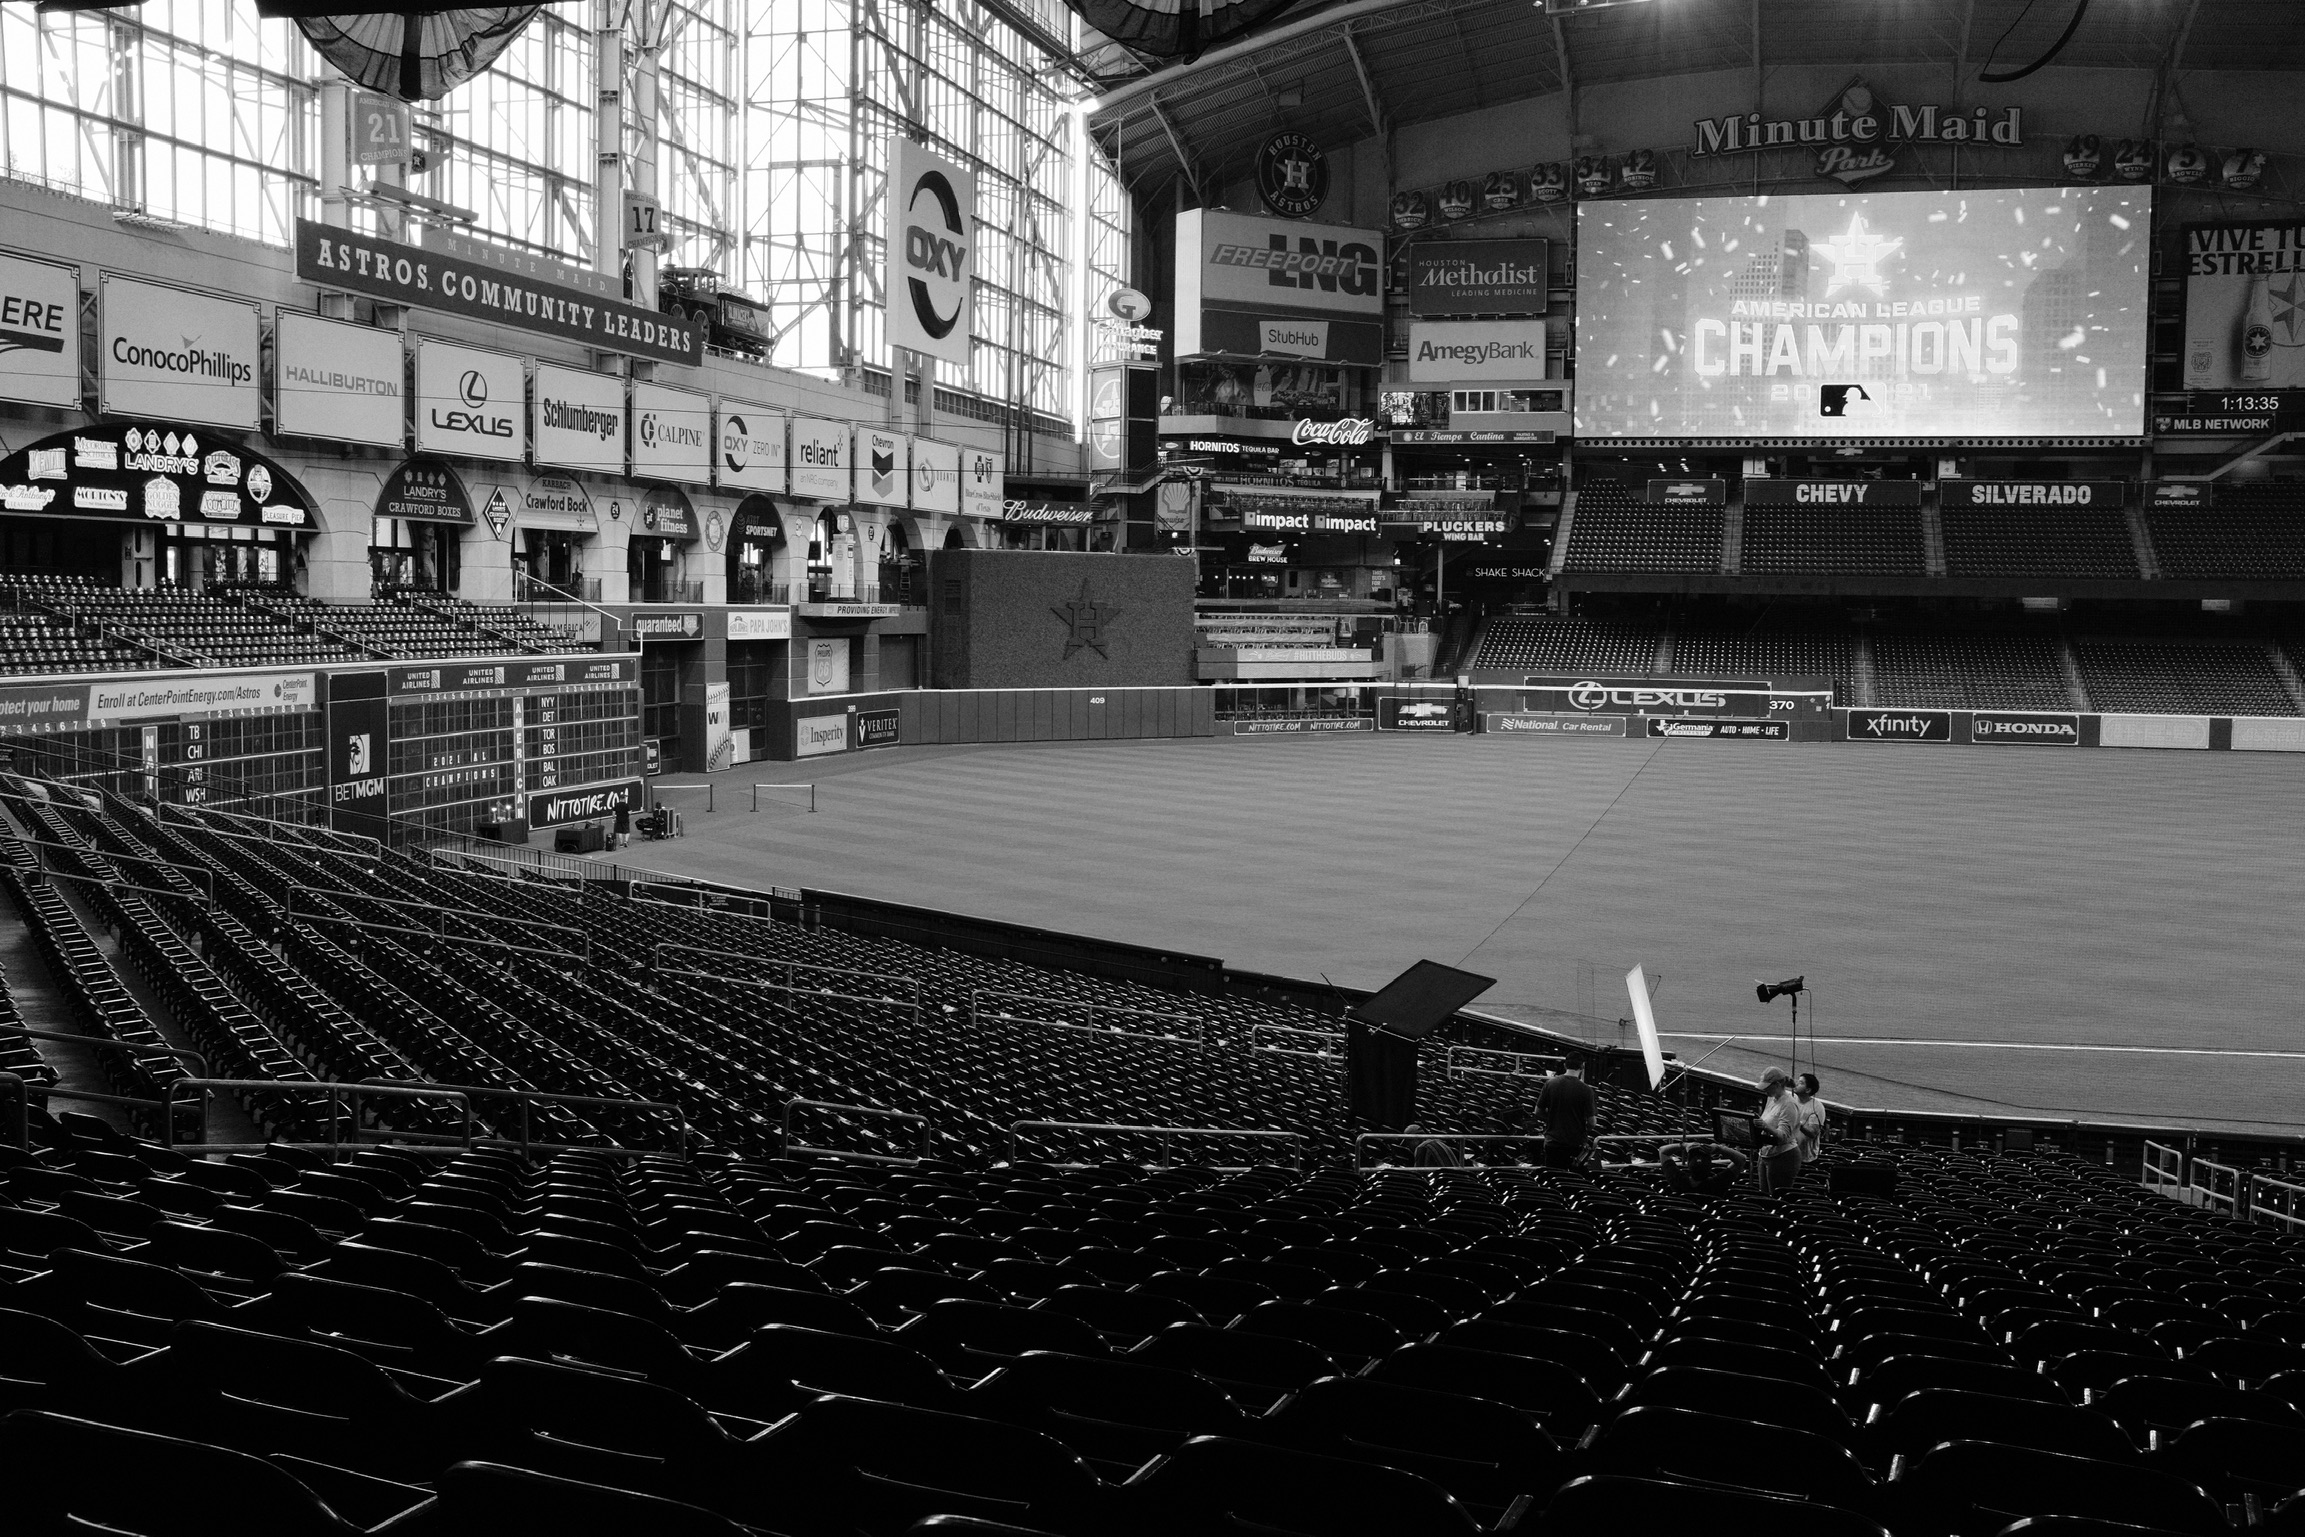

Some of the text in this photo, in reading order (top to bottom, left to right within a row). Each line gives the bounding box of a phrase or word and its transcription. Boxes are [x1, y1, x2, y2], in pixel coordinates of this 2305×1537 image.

[368, 112, 400, 143] 21
[1694, 105, 2023, 155] Minute Maid
[360, 148, 408, 161] CHAMPIONS
[1268, 134, 1322, 161] HOUSTON
[2065, 134, 2100, 159] 49
[2116, 138, 2151, 163] 24
[2180, 142, 2197, 168] 5
[1578, 156, 1609, 178] 34
[1623, 149, 1655, 172] 42
[1817, 147, 1894, 179] Park
[2236, 148, 2253, 173] 7
[1285, 159, 1309, 189] H
[1532, 162, 1562, 186] 33
[1440, 181, 1470, 204] 40
[1485, 172, 1517, 196] 25
[1270, 190, 1319, 213] ASTROS
[1395, 190, 1424, 214] 32
[632, 206, 655, 233] 17
[2194, 229, 2264, 251] VIVE
[447, 238, 536, 272] MINUTE
[906, 225, 967, 283] OXY
[1214, 234, 1378, 296] FREEPORT LNG
[1419, 259, 1466, 267] HOUSTON
[1419, 263, 1537, 286] Methodist
[317, 239, 429, 290] ASTROS
[442, 271, 595, 330] COMMUNITY
[604, 311, 691, 353] LEADERS
[1451, 288, 1537, 297] LEADING MEDICINE
[1732, 297, 1980, 318] AMERICAN LEAGUE
[1268, 329, 1319, 347] StubHub
[1694, 314, 2019, 376] CHAMPIONS
[112, 337, 251, 386] ConocoPhillips
[1417, 341, 1535, 365] AmegyBank
[286, 365, 398, 397] HALLIBURTON
[1770, 384, 1931, 401] 20 21
[2221, 397, 2279, 411] 1:13:35
[431, 408, 513, 438] LEXUS
[543, 398, 618, 441] Schlumberger
[2174, 418, 2270, 430] MLB NETWORK
[658, 424, 702, 447] CALPINE
[1292, 418, 1374, 446] Coca-Cola
[1415, 432, 1504, 442] El Tiempo Cantina
[724, 436, 769, 456] OXY ZERO
[872, 434, 894, 449] Chevron
[1190, 441, 1280, 455] HORNITOS TEQUILA BAR
[800, 439, 838, 467] reliant
[126, 453, 198, 475] LANDRY'S
[205, 452, 240, 476] SALTGRASS
[542, 479, 571, 490] KARBACH
[817, 478, 838, 490] company
[937, 471, 956, 483] QUANTA
[1240, 475, 1321, 487] HORNITOS TEQUILA
[19, 485, 53, 502] Anthony's
[77, 488, 127, 501] MORTON'S
[147, 490, 178, 499] GOLDEN
[404, 485, 447, 499] LANDRY'S
[1796, 484, 1868, 503] CHEVY
[1971, 485, 2091, 504] SILVERADO
[147, 500, 178, 510] NUGGET
[203, 500, 240, 514] AQUARIUM
[389, 501, 461, 518] CRAWFORD BOXES
[526, 493, 588, 512] Crawford Bock
[612, 504, 619, 514] 24
[1003, 500, 1093, 522] Budweiser
[264, 510, 303, 524] PLEASURE PIER
[657, 504, 683, 521] planet
[1256, 510, 1309, 530] impact
[660, 519, 687, 534] fitness
[746, 525, 777, 537] SPORTSNET
[1326, 513, 1376, 533] impact
[1424, 521, 1505, 532] PLUCKERS
[1443, 533, 1484, 541] WING BAR
[1250, 545, 1283, 556] Budweiser
[1475, 568, 1545, 577] SHAKE SHACK
[837, 606, 870, 614] PROVIDING
[871, 606, 888, 614] ENERGY
[636, 616, 682, 637] guaranteed
[750, 619, 787, 633] PAPA JOHN'S
[1294, 650, 1347, 661] #HITTHEBUDS
[407, 672, 430, 680] UNITED
[820, 661, 829, 677] 66
[402, 680, 430, 689] AIRLINES
[462, 676, 493, 685] AIRLINES
[98, 686, 261, 709] Enroll at CenterPointEnergy.com/Astros
[283, 692, 298, 702] Energy
[541, 697, 555, 707] NYY
[1611, 689, 1726, 707] LEXUS
[1769, 700, 1794, 710] 370
[27, 696, 80, 717] your home
[542, 711, 555, 722] DET
[867, 718, 897, 731] VERITEX
[1310, 720, 1360, 730] NITTOTIRE.COM
[1514, 718, 1611, 731] National Car Rental
[1866, 713, 1931, 736] xfinity
[189, 725, 200, 740] TB
[543, 729, 555, 740] TOR
[810, 724, 843, 746] Insperity
[1249, 722, 1300, 732] NITTOTIRE.COM
[1673, 722, 1713, 731] Germania
[1720, 726, 1779, 735] AUTO HOME LIFE
[1994, 721, 2076, 735] HONDA
[187, 745, 203, 759] CHI
[543, 744, 555, 755] BOS
[434, 752, 486, 767] 2021 AL
[515, 703, 523, 819] AMERICAN
[543, 761, 555, 772] BAL
[188, 767, 203, 782] ARI
[426, 769, 494, 787] CHAMPIONS
[542, 775, 557, 787] OAK
[186, 787, 206, 803] WSH
[335, 778, 384, 802] BETMGM
